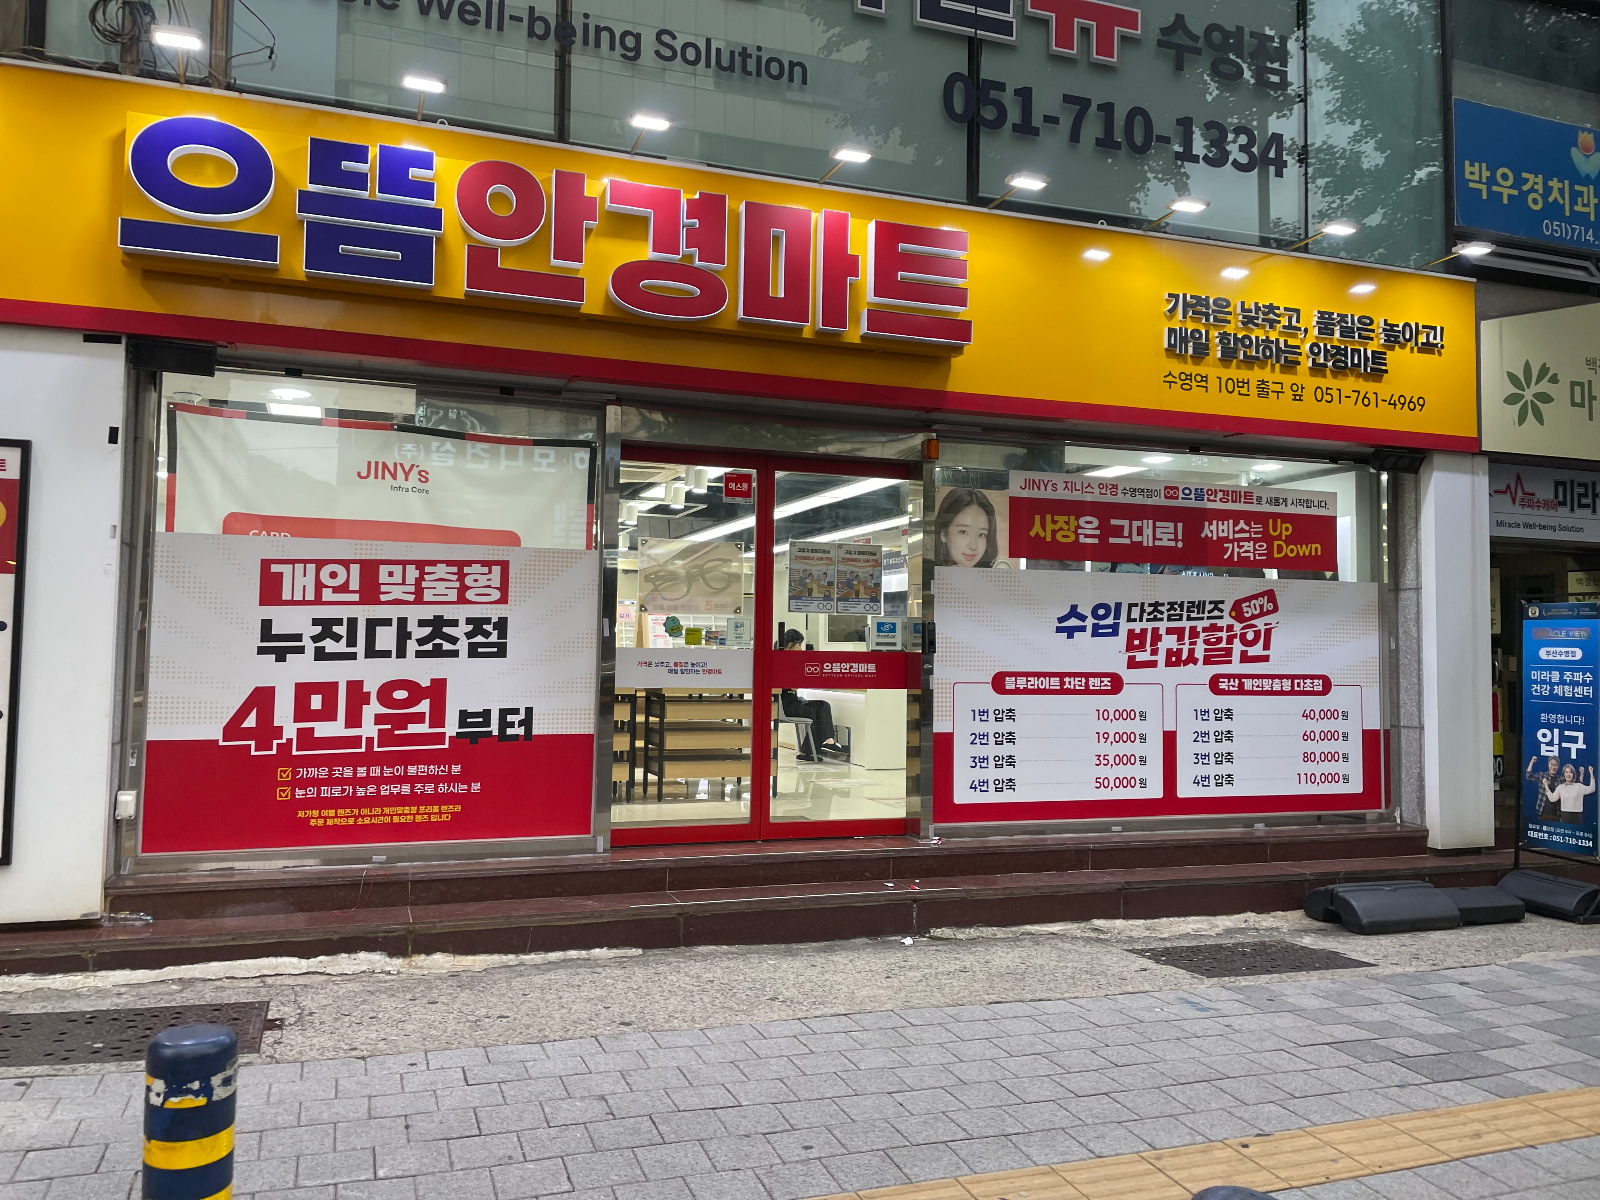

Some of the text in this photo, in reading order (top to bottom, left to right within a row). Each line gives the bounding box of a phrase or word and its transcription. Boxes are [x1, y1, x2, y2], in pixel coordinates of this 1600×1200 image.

[416, 0, 642, 62] Well-being
[653, 28, 808, 86] Solution
[1157, 14, 1288, 91] 수영점
[943, 72, 1288, 178] 051-710-1334
[1465, 160, 1599, 222] 박우경치과
[118, 115, 973, 346] 으뜸안경마트
[1543, 220, 1600, 244] 051)714.
[1164, 292, 1444, 350] 가격은 낮추고, 품질은 높이고!
[1164, 327, 1389, 375] 매일 할인하는 안경마트
[1163, 371, 1426, 412] 수영역 10번 출구 앞 051-761-4969
[411, 486, 430, 494] Core
[728, 482, 748, 491] 에스원
[1063, 481, 1094, 494] 지니스
[1098, 483, 1118, 496] 안경
[1121, 487, 1161, 499] 수영역점이
[1266, 496, 1288, 507] 새롭게
[1291, 498, 1330, 511] 시작합니다.
[1519, 497, 1558, 512] 주파수케어
[1029, 514, 1183, 548] 사장은 그대로!
[1201, 519, 1292, 540] 서비스는 Up
[1496, 520, 1584, 533] Miracle Well-being Solution
[1223, 541, 1321, 561] 가격은 Down
[271, 563, 501, 602] 개인 맞춤형
[1242, 596, 1274, 617] 50%
[1055, 600, 1225, 639] 수입 다초점렌즈
[257, 615, 508, 662] 누진다초점
[1569, 630, 1588, 638] VIEW
[1124, 622, 1278, 669] 반값할인
[823, 663, 876, 673] 으뜸안경마트
[1005, 677, 1111, 690] 블루라이트 차단 렌즈
[1219, 679, 1323, 691] 국산 개인맞춤형 다초점
[1531, 671, 1593, 684] 미라클 주파수
[1531, 684, 1593, 698] 건강 체험센터
[221, 678, 533, 754] 4만원 부터
[971, 708, 1147, 723] 1번 압축 10,000 원
[1193, 708, 1349, 723] 1번 압축 40,000 원
[1540, 713, 1585, 725] 환영합니다!
[969, 731, 1147, 746] 2번 압축 19,000 원
[1193, 730, 1349, 744] 2번 압축 60,000 원
[1536, 728, 1587, 759] 입구
[969, 754, 1147, 769] 3번 압축 35,000 원
[1193, 751, 1349, 765] 3번 압축 80,000 원
[296, 764, 462, 779] 가까운 곳을 볼 때 눈이 불편하신 분
[969, 777, 1147, 792] 4번 압축 50,000 원
[1193, 773, 1349, 787] 4번 압축 110,000 원
[295, 782, 481, 798] 눈의 피로가 높은 업무를 주로 하시는 분
[297, 809, 319, 818] 저가형
[360, 806, 381, 815] 아니라
[382, 805, 417, 815] 개인맞춤형
[310, 818, 324, 826] 주문
[326, 817, 355, 826] 제작으로
[356, 816, 391, 824] 소요시간이
[393, 815, 413, 823] 필요한
[431, 813, 451, 822] 입니다
[1552, 834, 1593, 847] 051-710-1334
